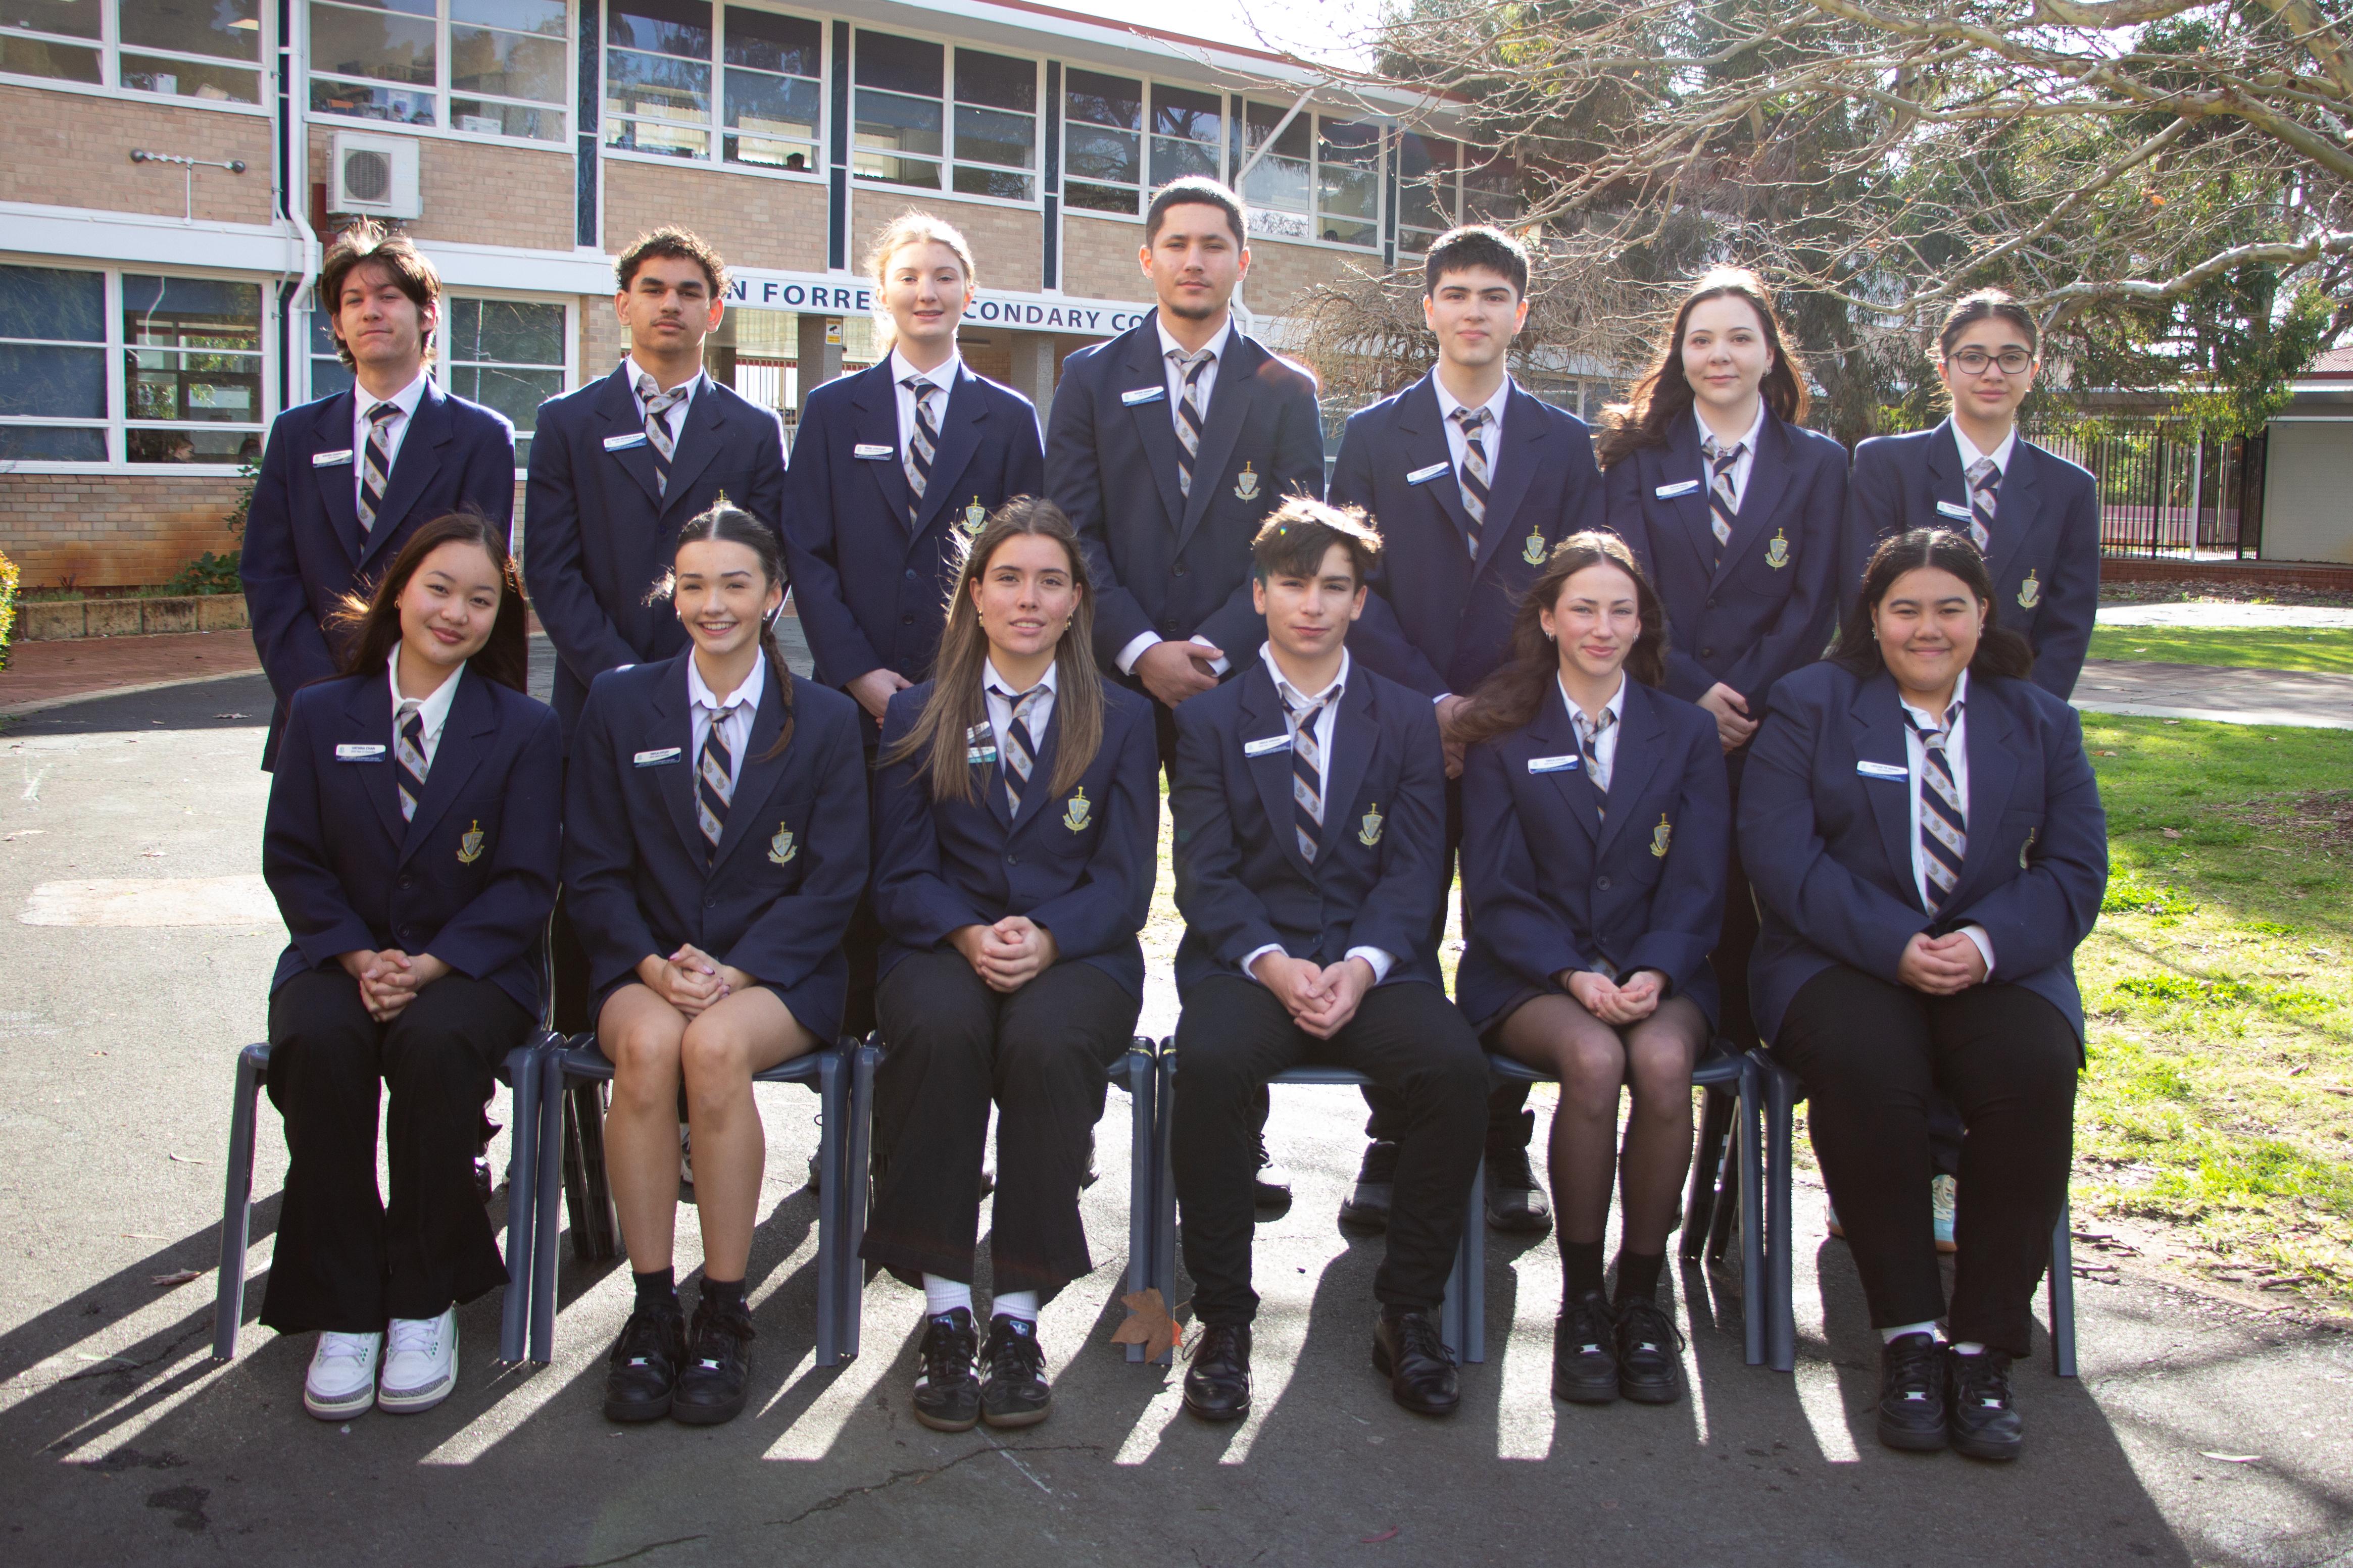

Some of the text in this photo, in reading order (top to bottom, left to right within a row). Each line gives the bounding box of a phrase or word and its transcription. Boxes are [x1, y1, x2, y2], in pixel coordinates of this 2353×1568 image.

[726, 280, 746, 300] N
[763, 282, 870, 311] FORRE
[962, 300, 1101, 329] CONDARY
